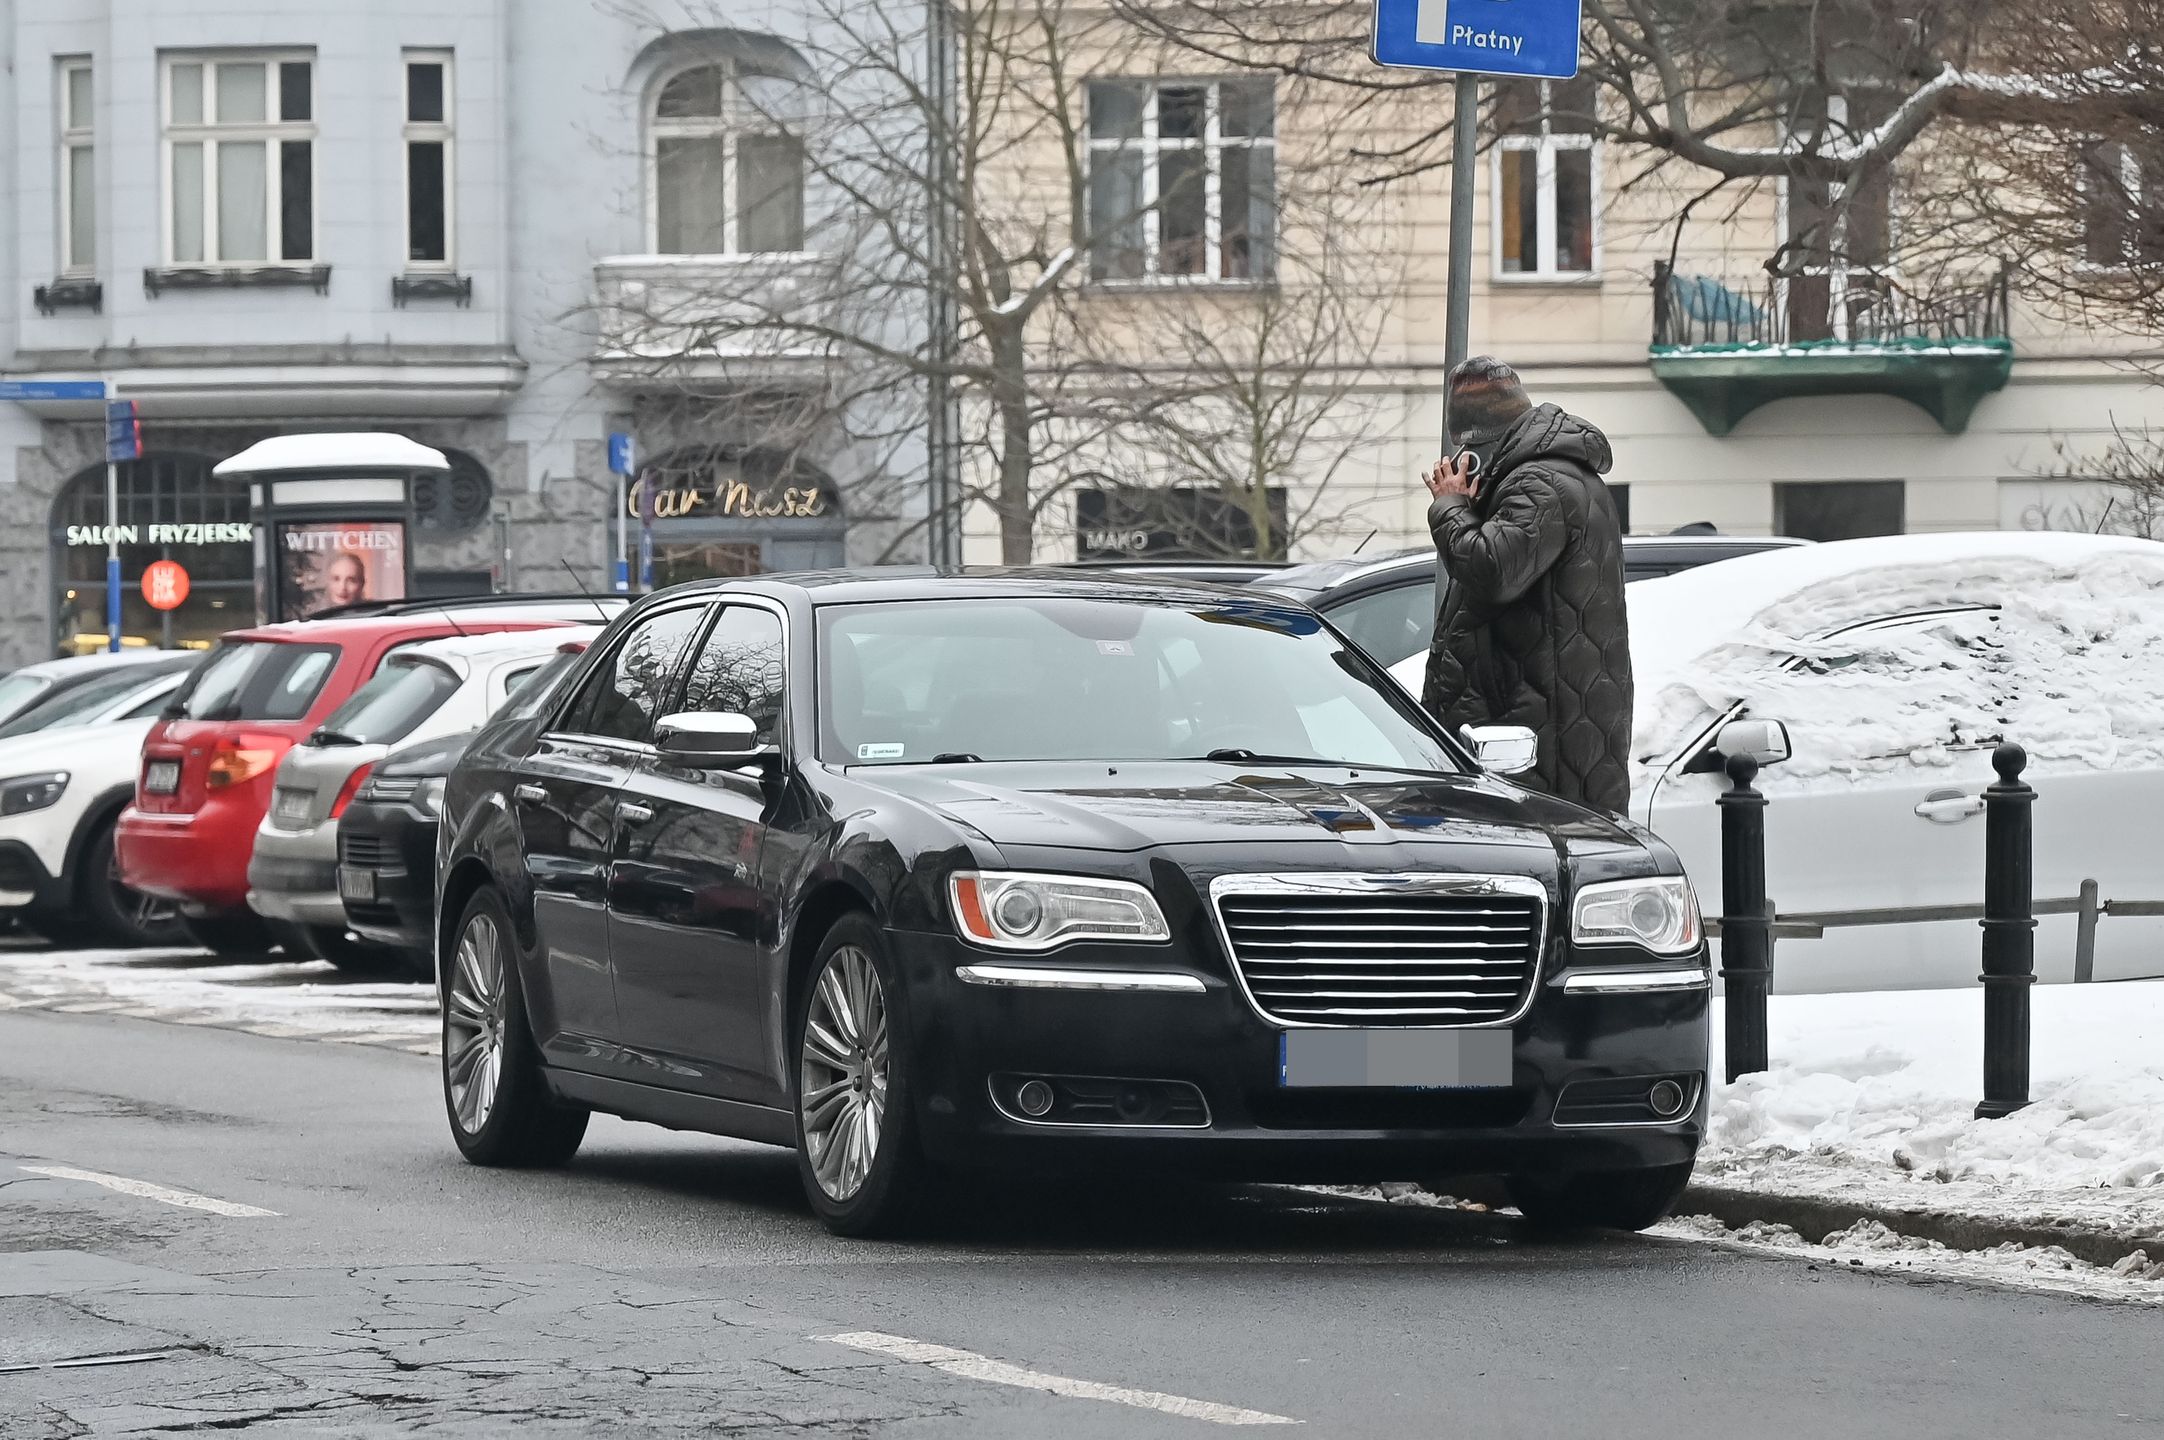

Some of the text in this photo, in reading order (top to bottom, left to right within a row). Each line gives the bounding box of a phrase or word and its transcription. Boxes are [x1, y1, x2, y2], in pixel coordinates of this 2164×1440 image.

[1452, 24, 1523, 57] Płatny
[714, 478, 825, 518] Nasz
[66, 524, 138, 546] SALON
[285, 530, 399, 551] WITTCHEN
